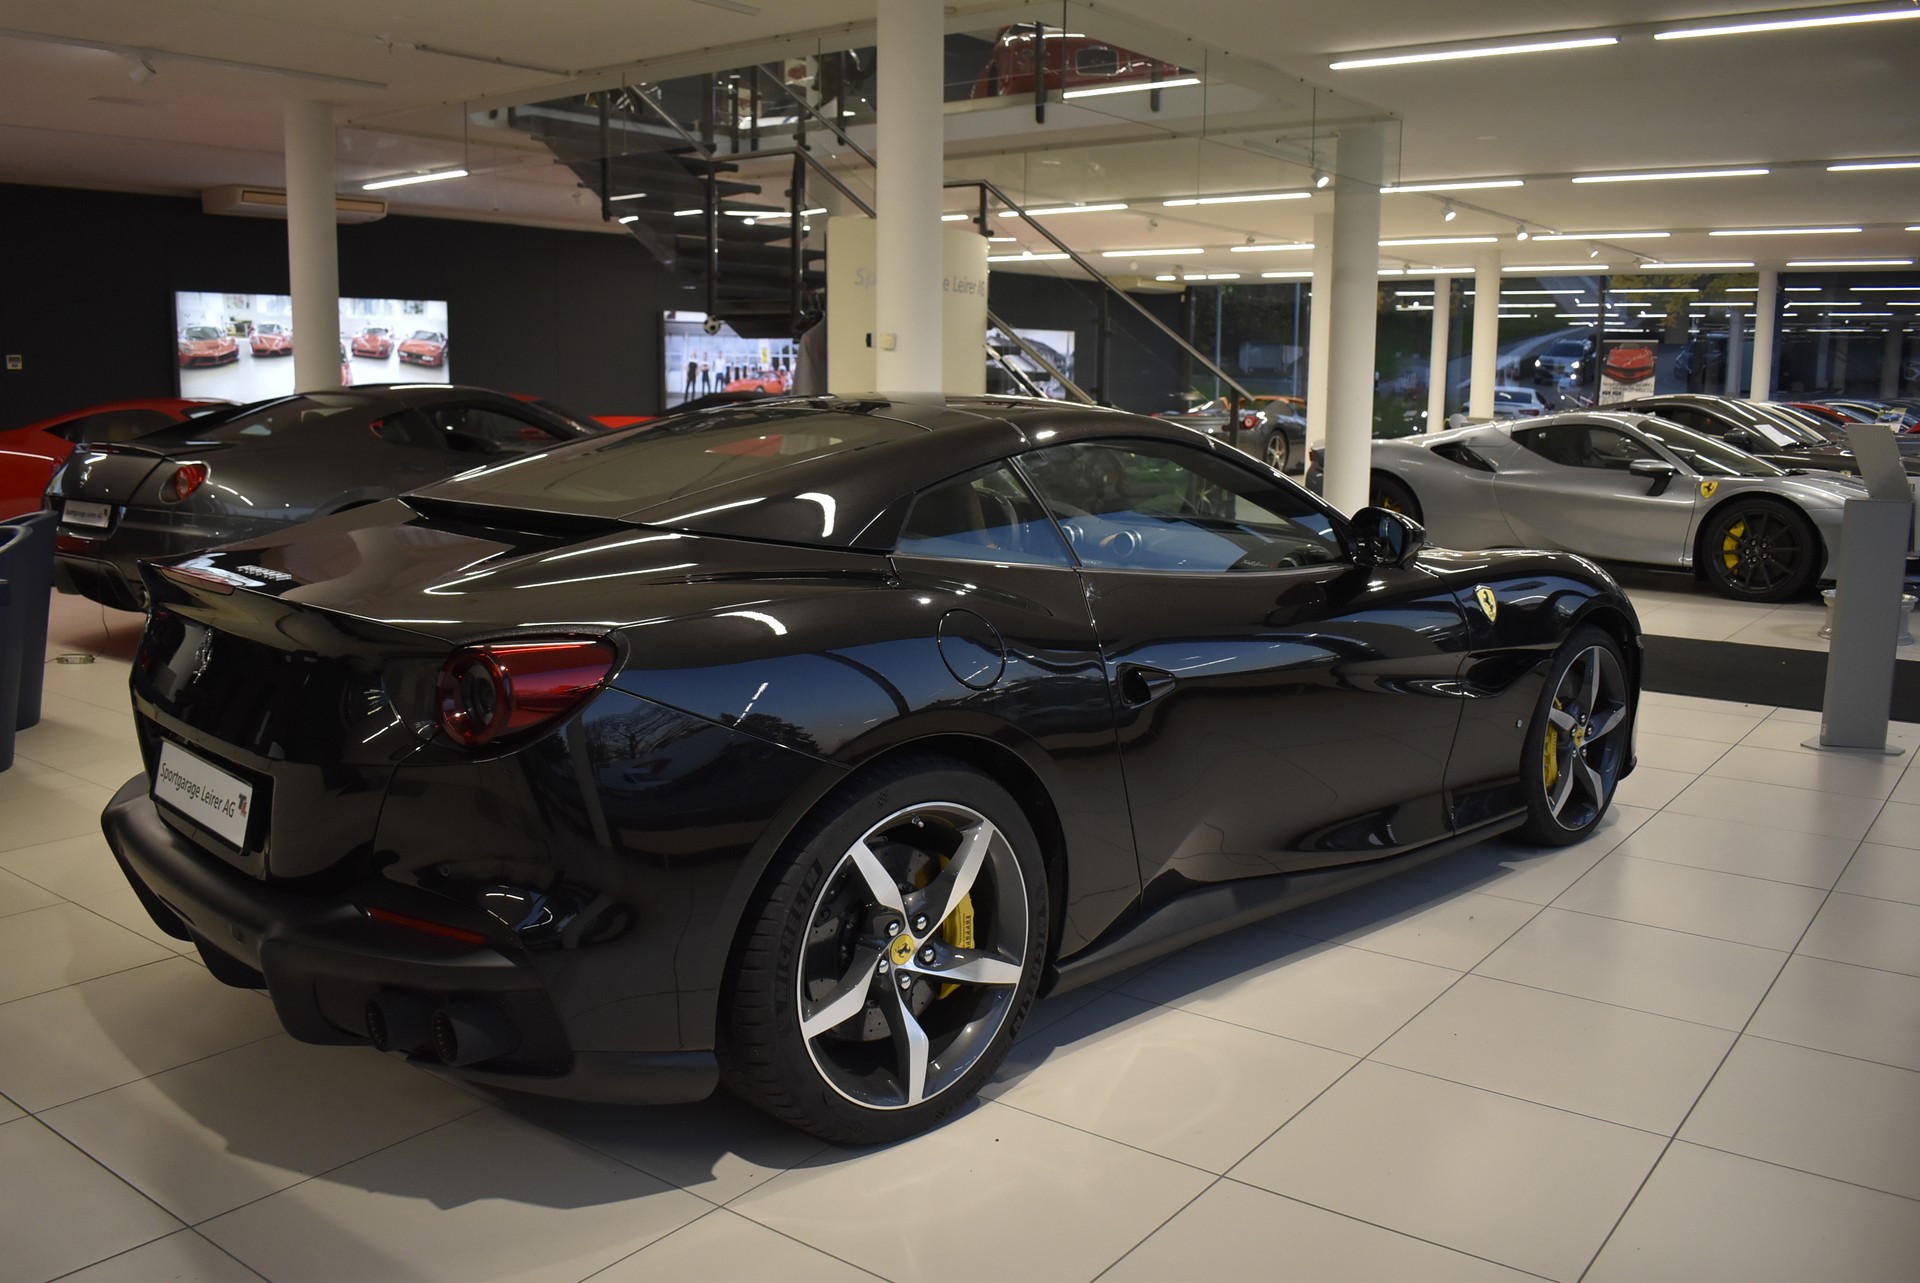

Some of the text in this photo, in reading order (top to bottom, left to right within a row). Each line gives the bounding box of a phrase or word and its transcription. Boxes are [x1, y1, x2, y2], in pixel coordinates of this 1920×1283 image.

[952, 275, 977, 295] Leirer
[160, 762, 236, 818] Sportgarage Leirer AG
[775, 862, 821, 1010] MICHELIN
[1009, 908, 1047, 1037] MICHELIN
